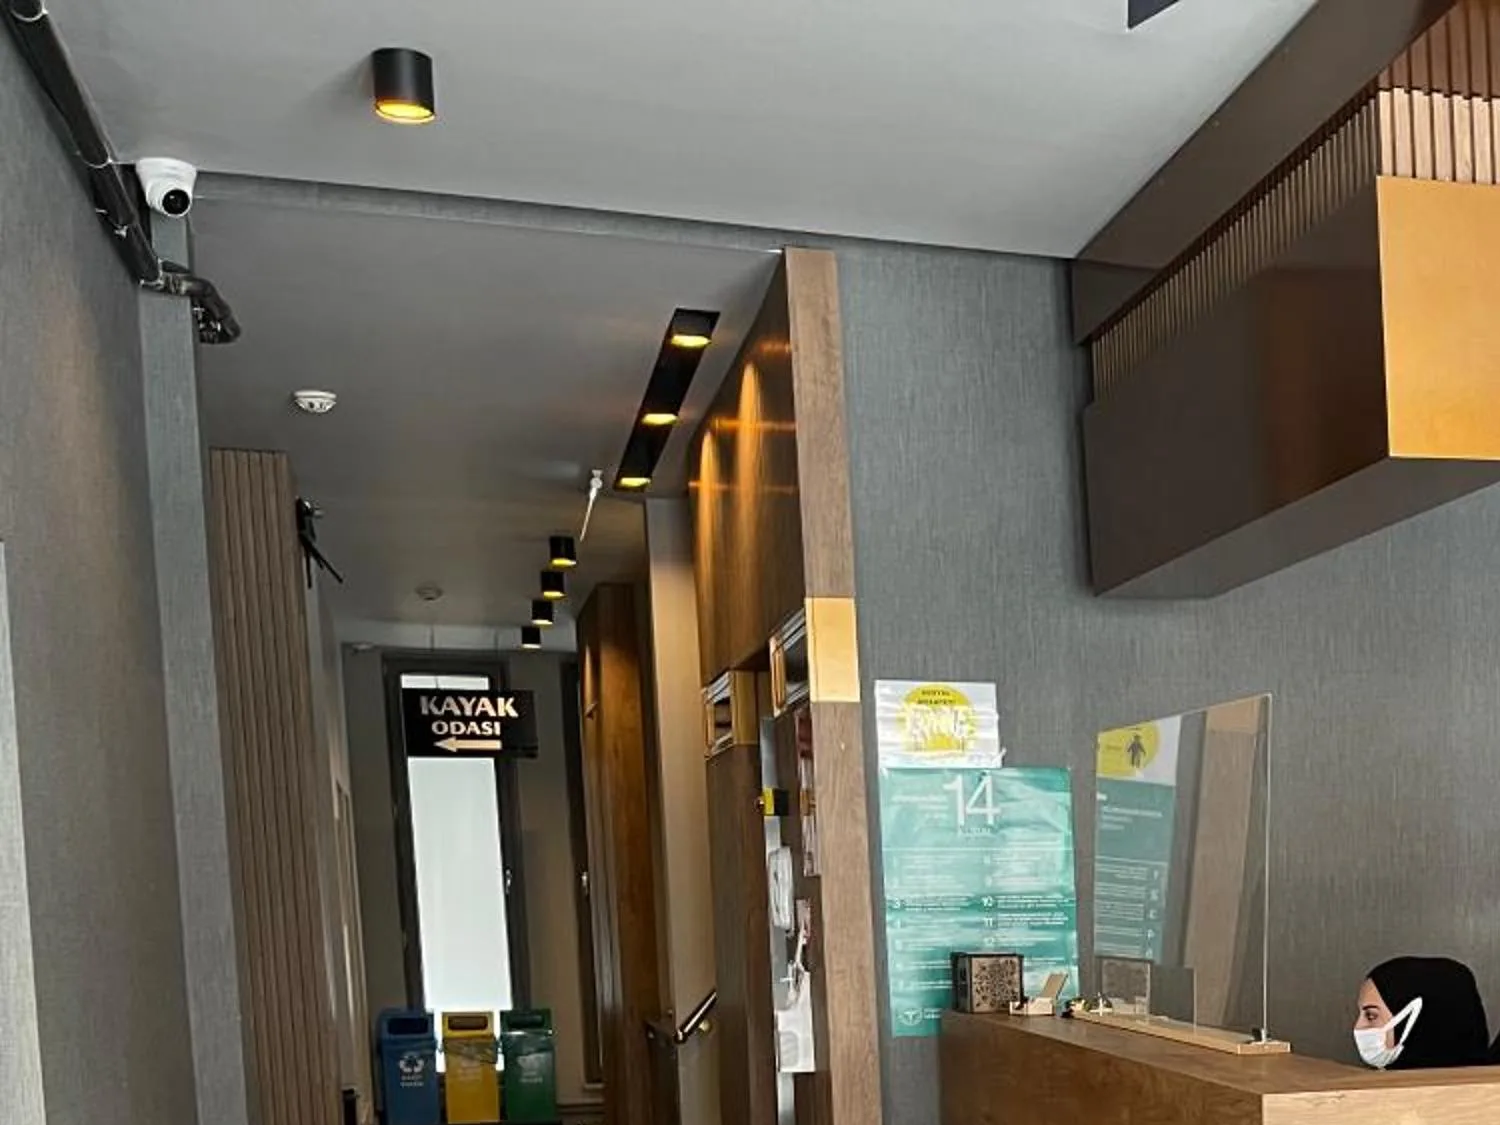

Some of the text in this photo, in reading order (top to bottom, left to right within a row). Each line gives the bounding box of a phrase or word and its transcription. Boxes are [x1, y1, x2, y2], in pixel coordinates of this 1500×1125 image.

[420, 695, 519, 718] KAYAK
[431, 721, 501, 736] ODASI
[943, 774, 1000, 826] 14
